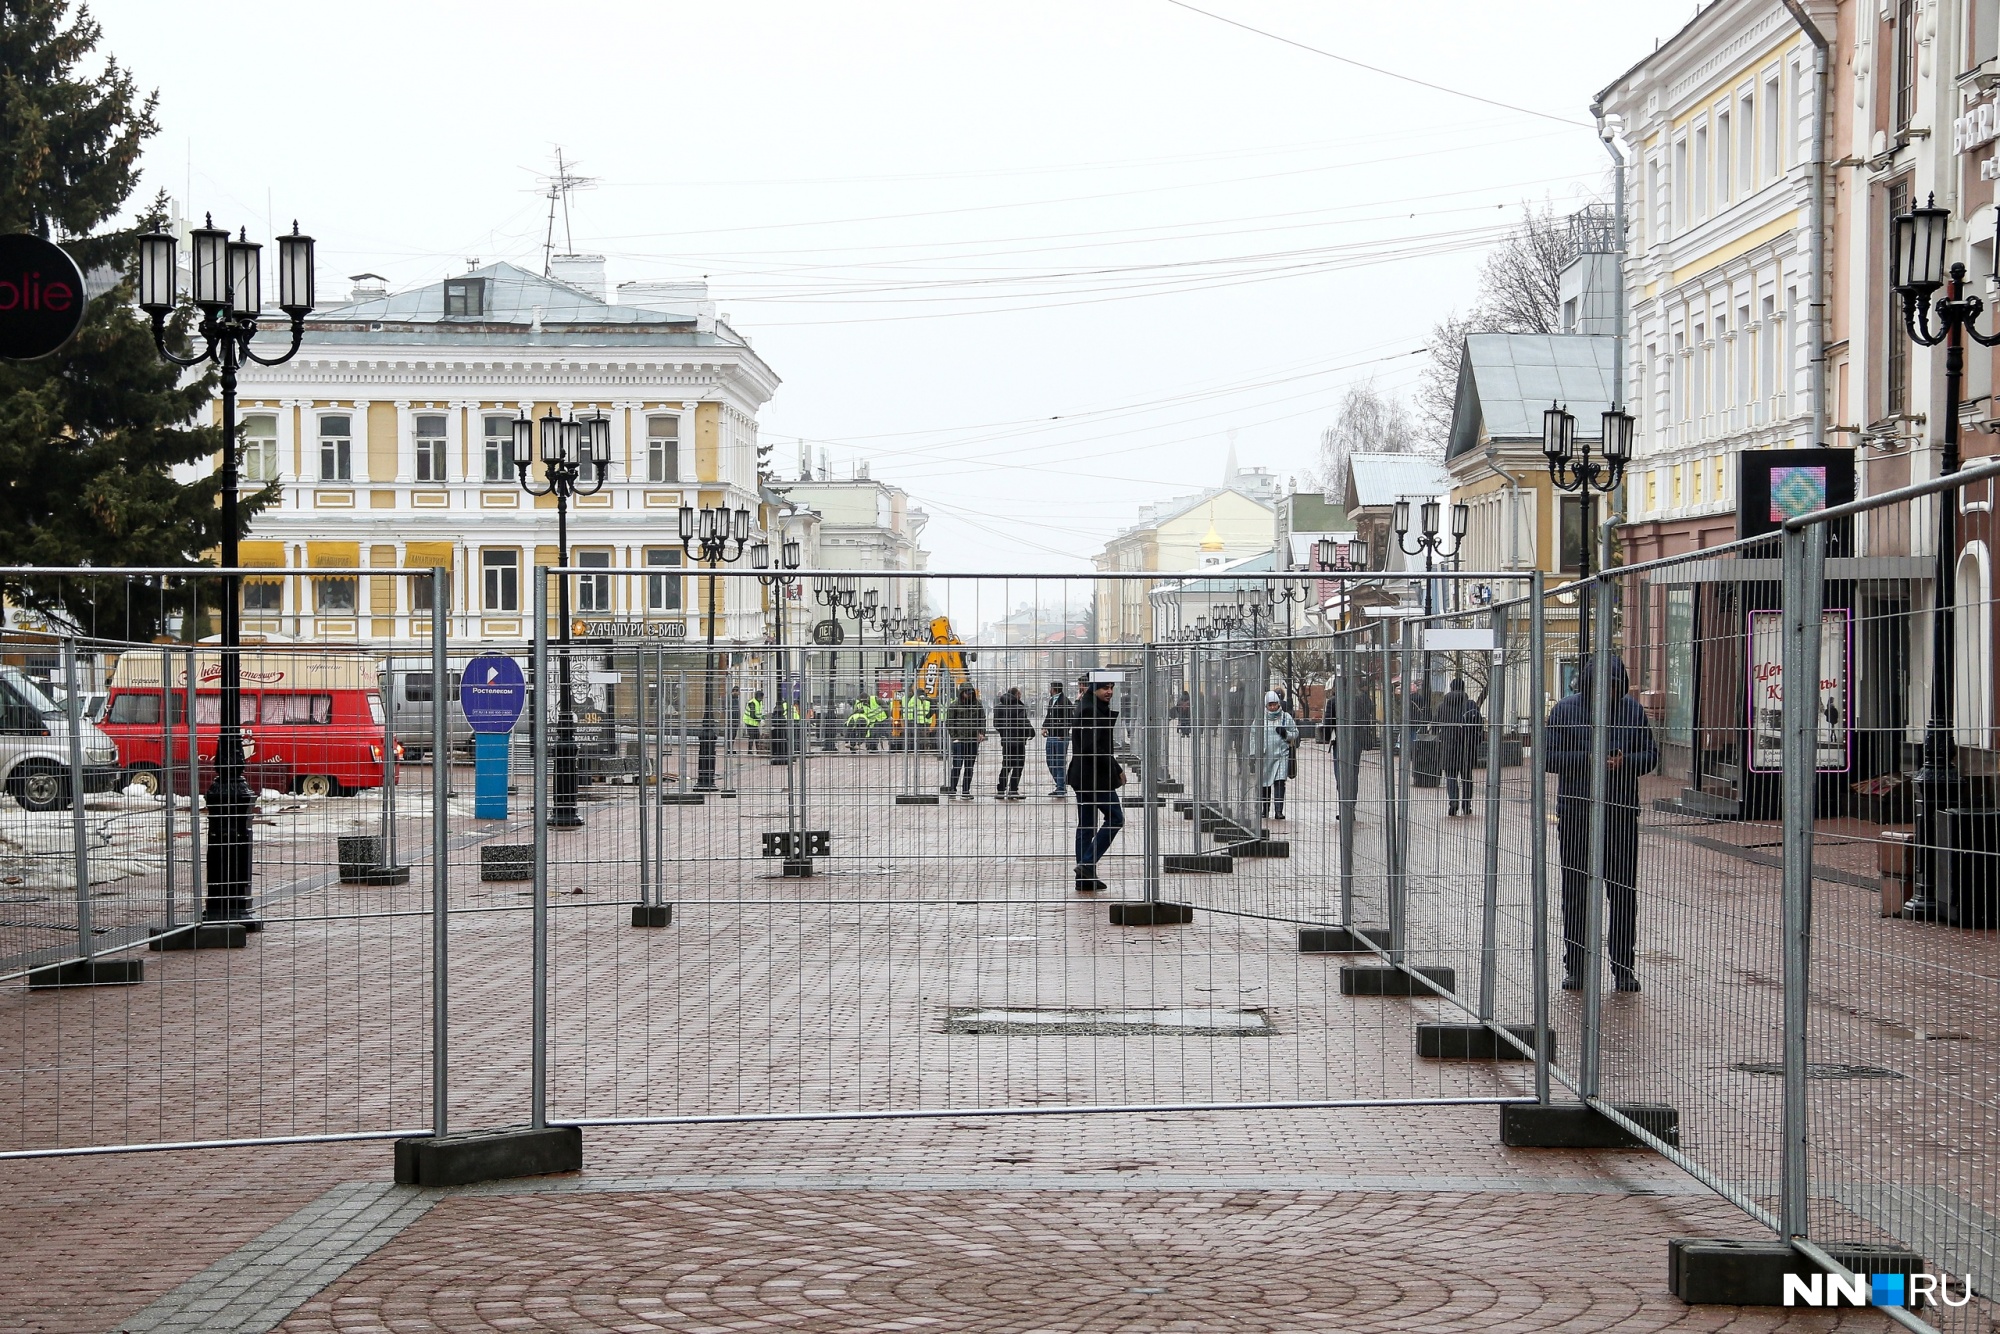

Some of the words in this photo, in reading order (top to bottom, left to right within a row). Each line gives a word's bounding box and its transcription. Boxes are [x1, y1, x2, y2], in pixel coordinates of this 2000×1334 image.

[589, 623, 644, 637] ХАЧАПУРИ
[659, 623, 685, 637] ВИНО
[925, 664, 938, 694] JCB
[472, 687, 513, 695] Ростелеком
